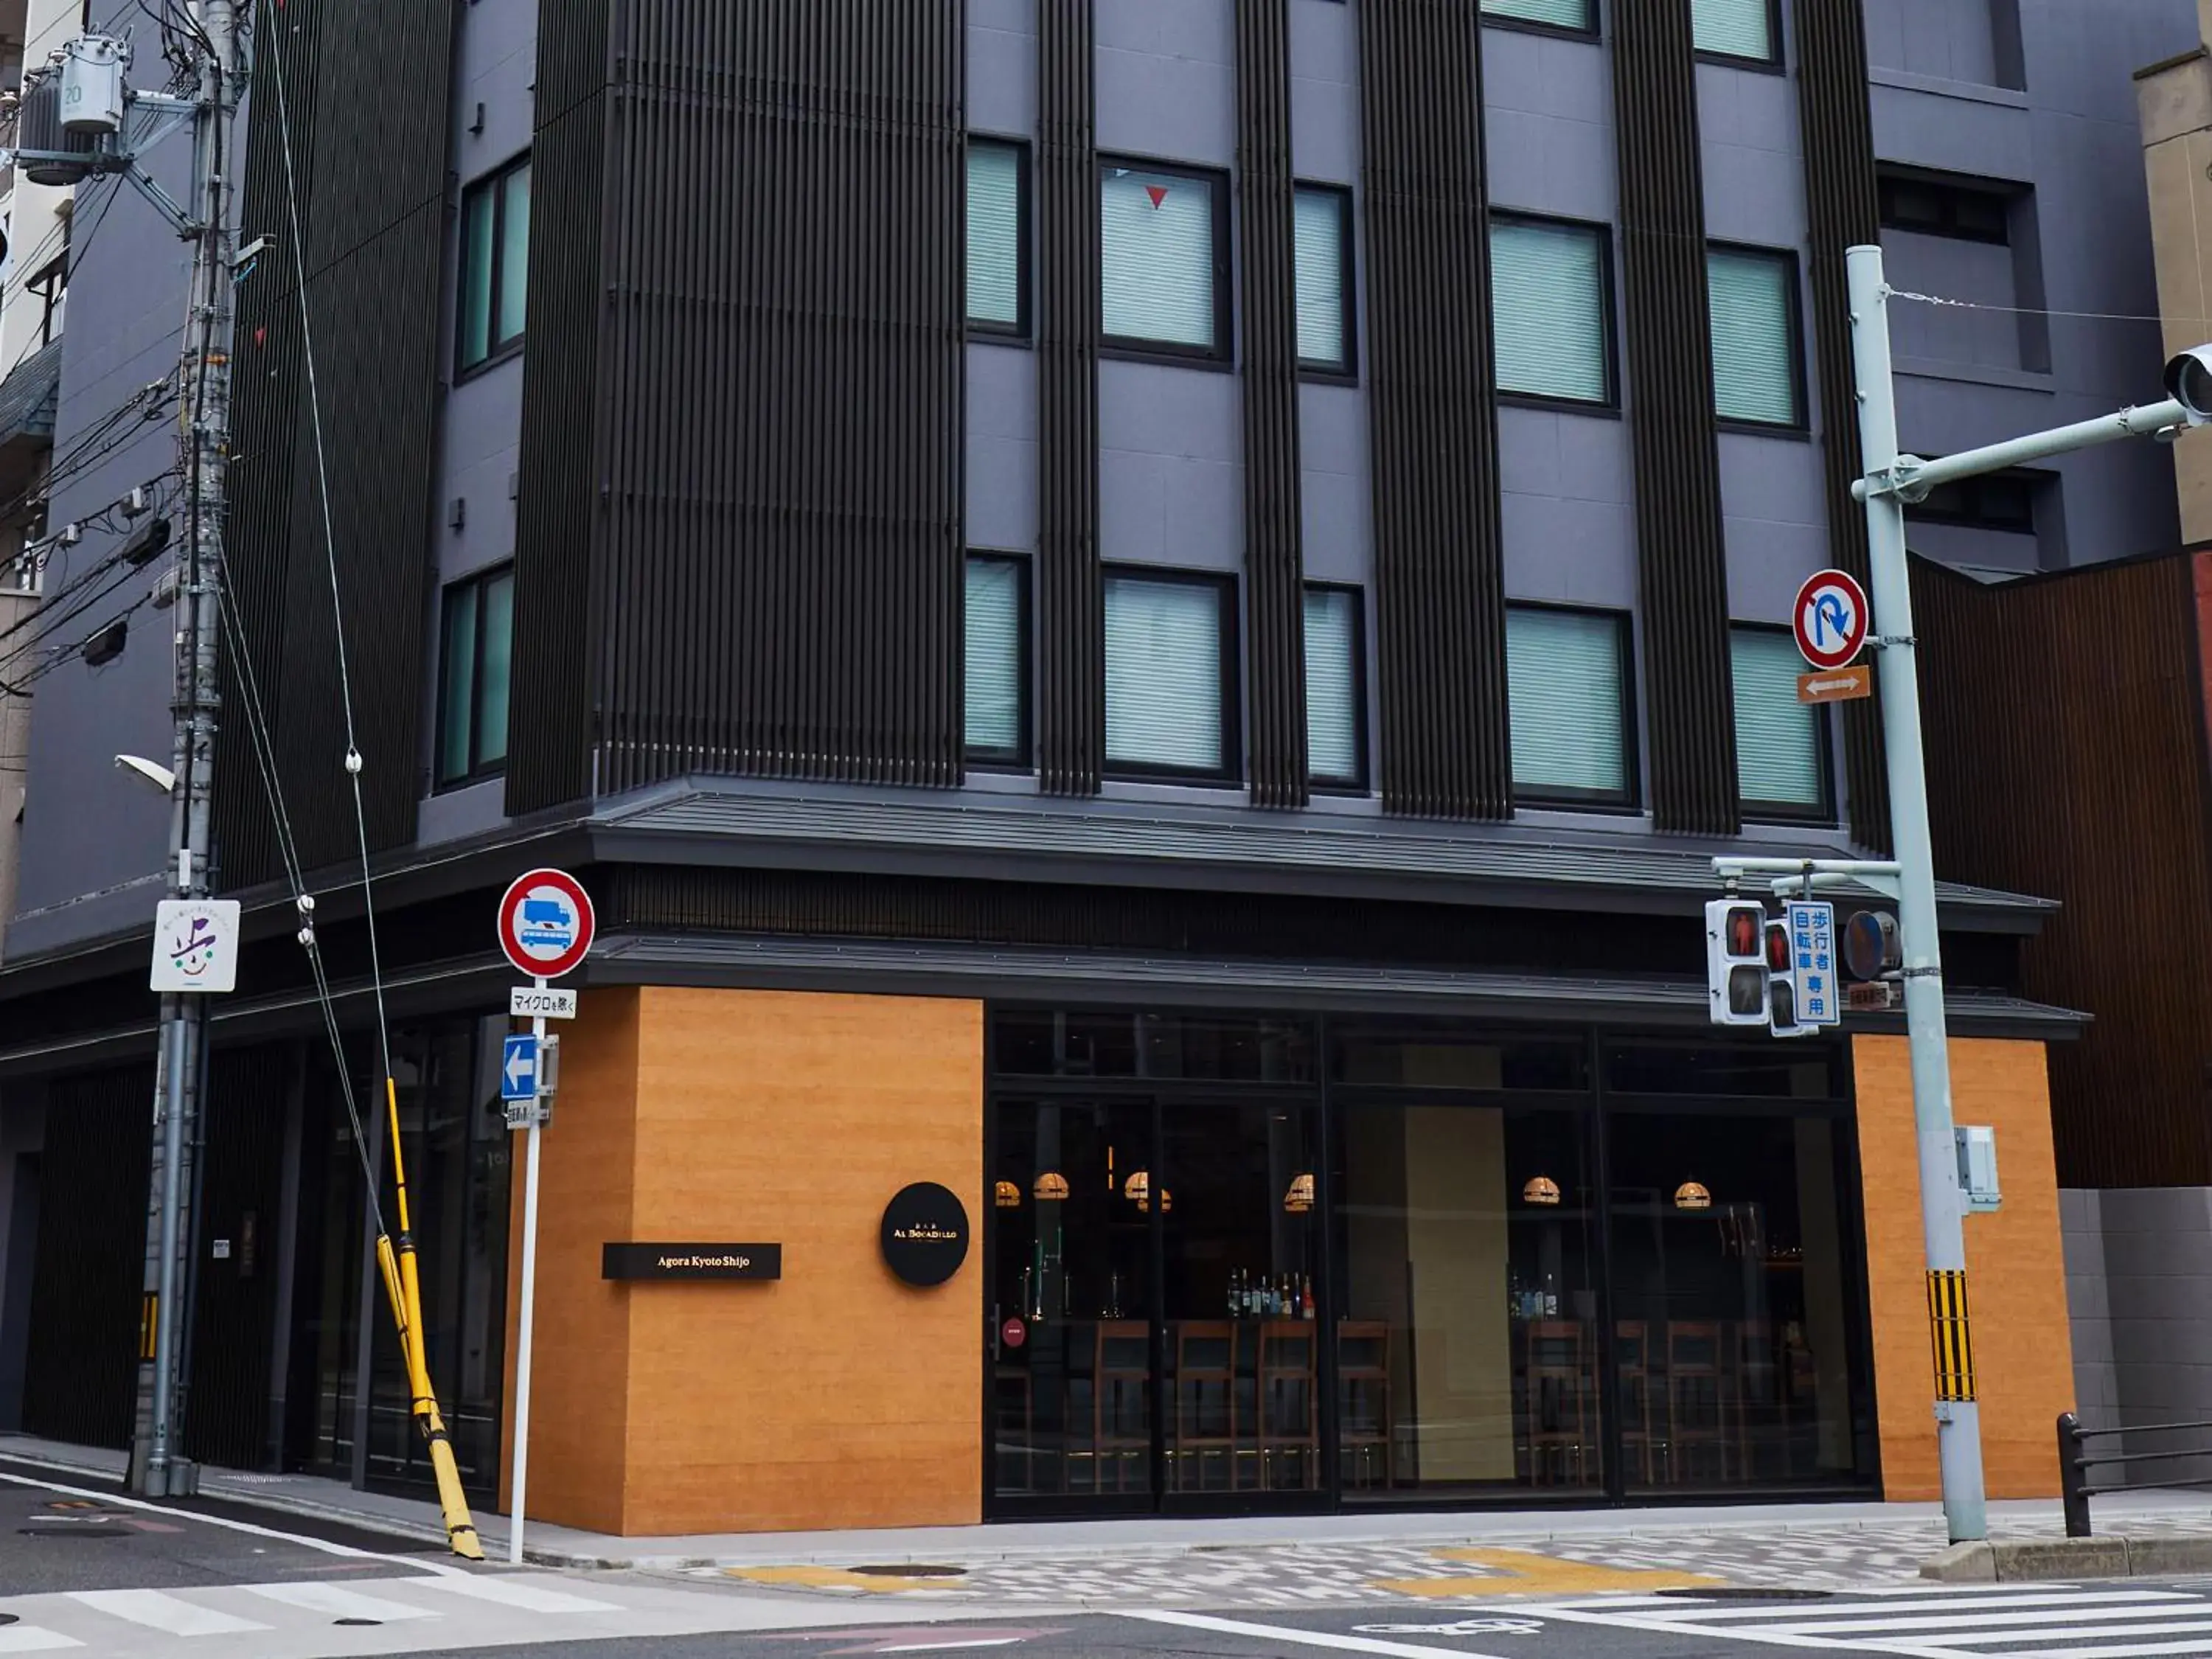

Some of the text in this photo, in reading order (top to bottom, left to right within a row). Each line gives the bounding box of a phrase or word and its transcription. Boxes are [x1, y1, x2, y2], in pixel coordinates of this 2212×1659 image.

[65, 85, 82, 104] 20
[1795, 911, 1812, 968] 自転車
[1812, 911, 1829, 970] 歩行者
[658, 1256, 750, 1268] Agora Kyoto Shijo
